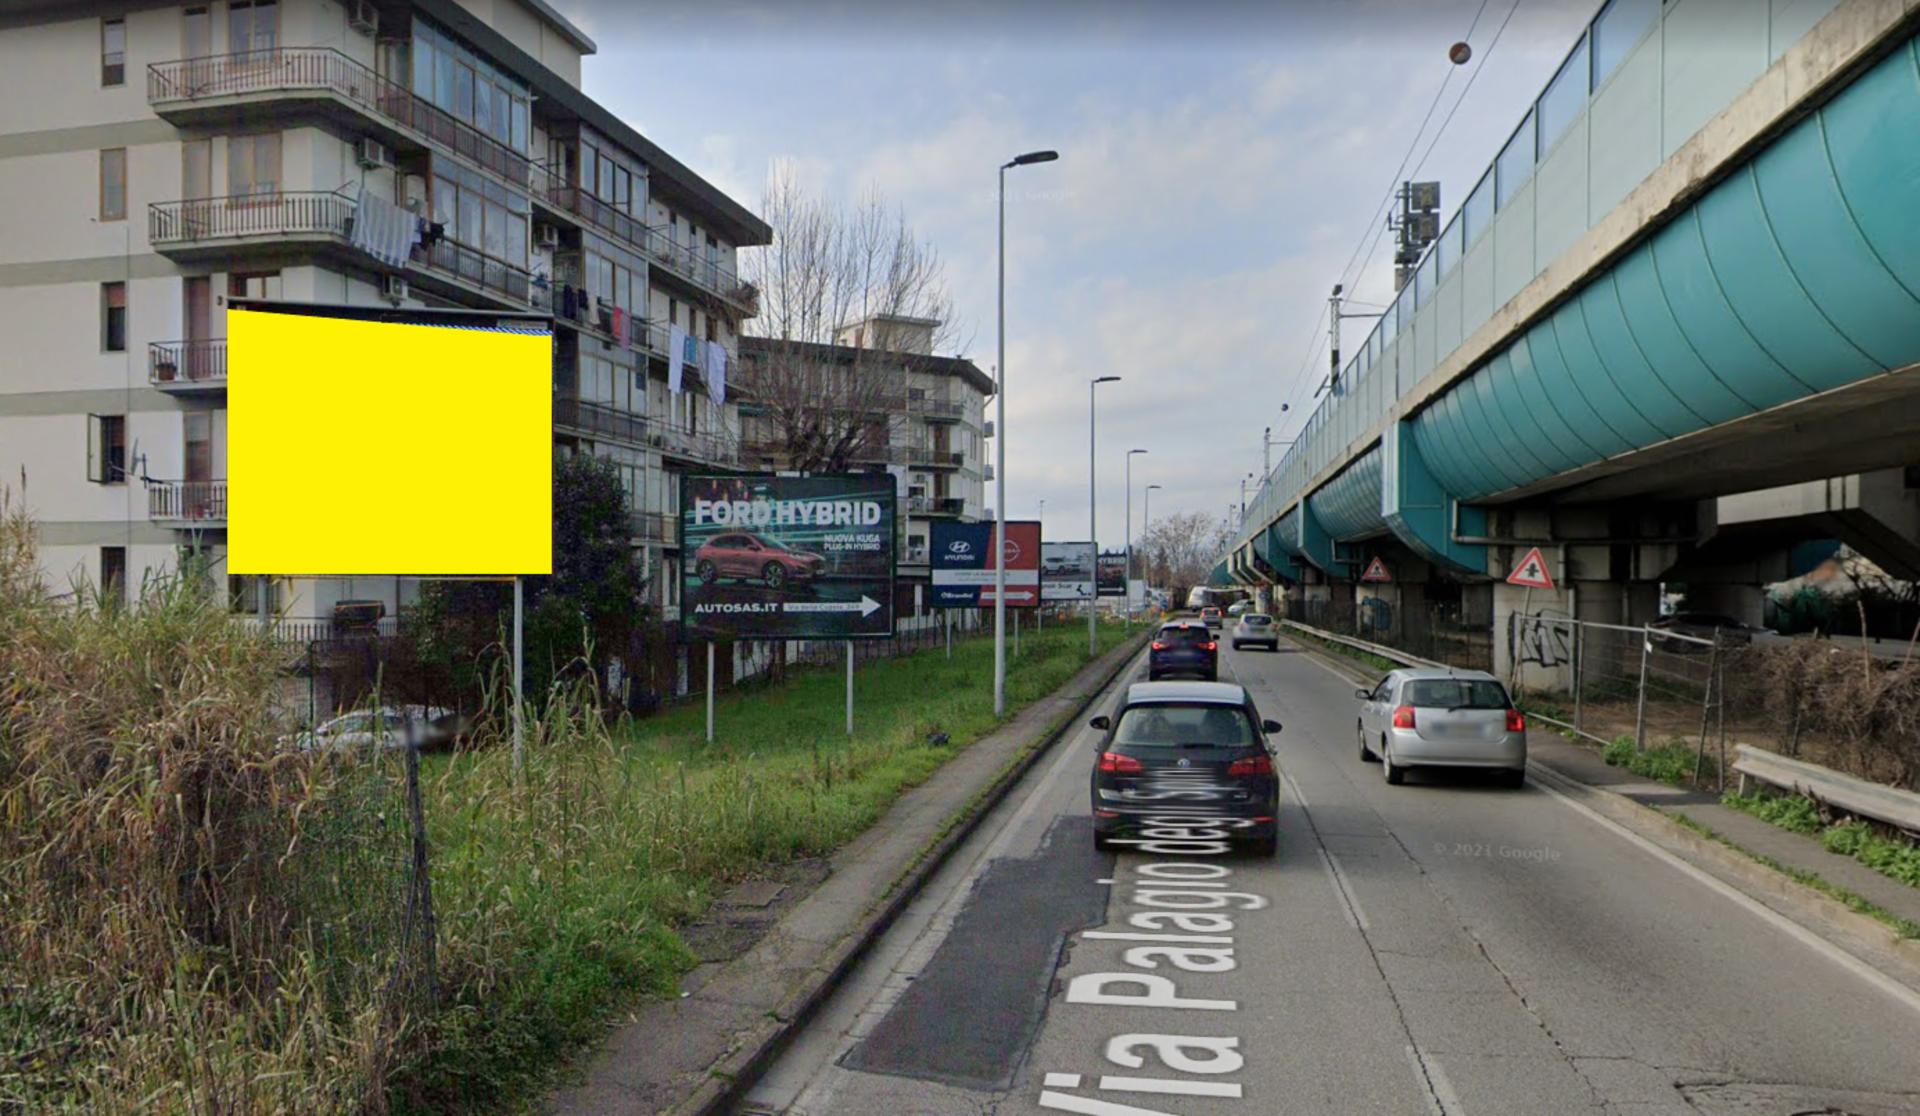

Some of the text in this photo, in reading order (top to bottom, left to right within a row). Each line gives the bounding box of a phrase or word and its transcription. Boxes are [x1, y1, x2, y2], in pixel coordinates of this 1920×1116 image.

[695, 499, 881, 525] FORD HYBRID
[856, 534, 880, 542] KUGA
[695, 603, 778, 613] AUTOSAS.IT
